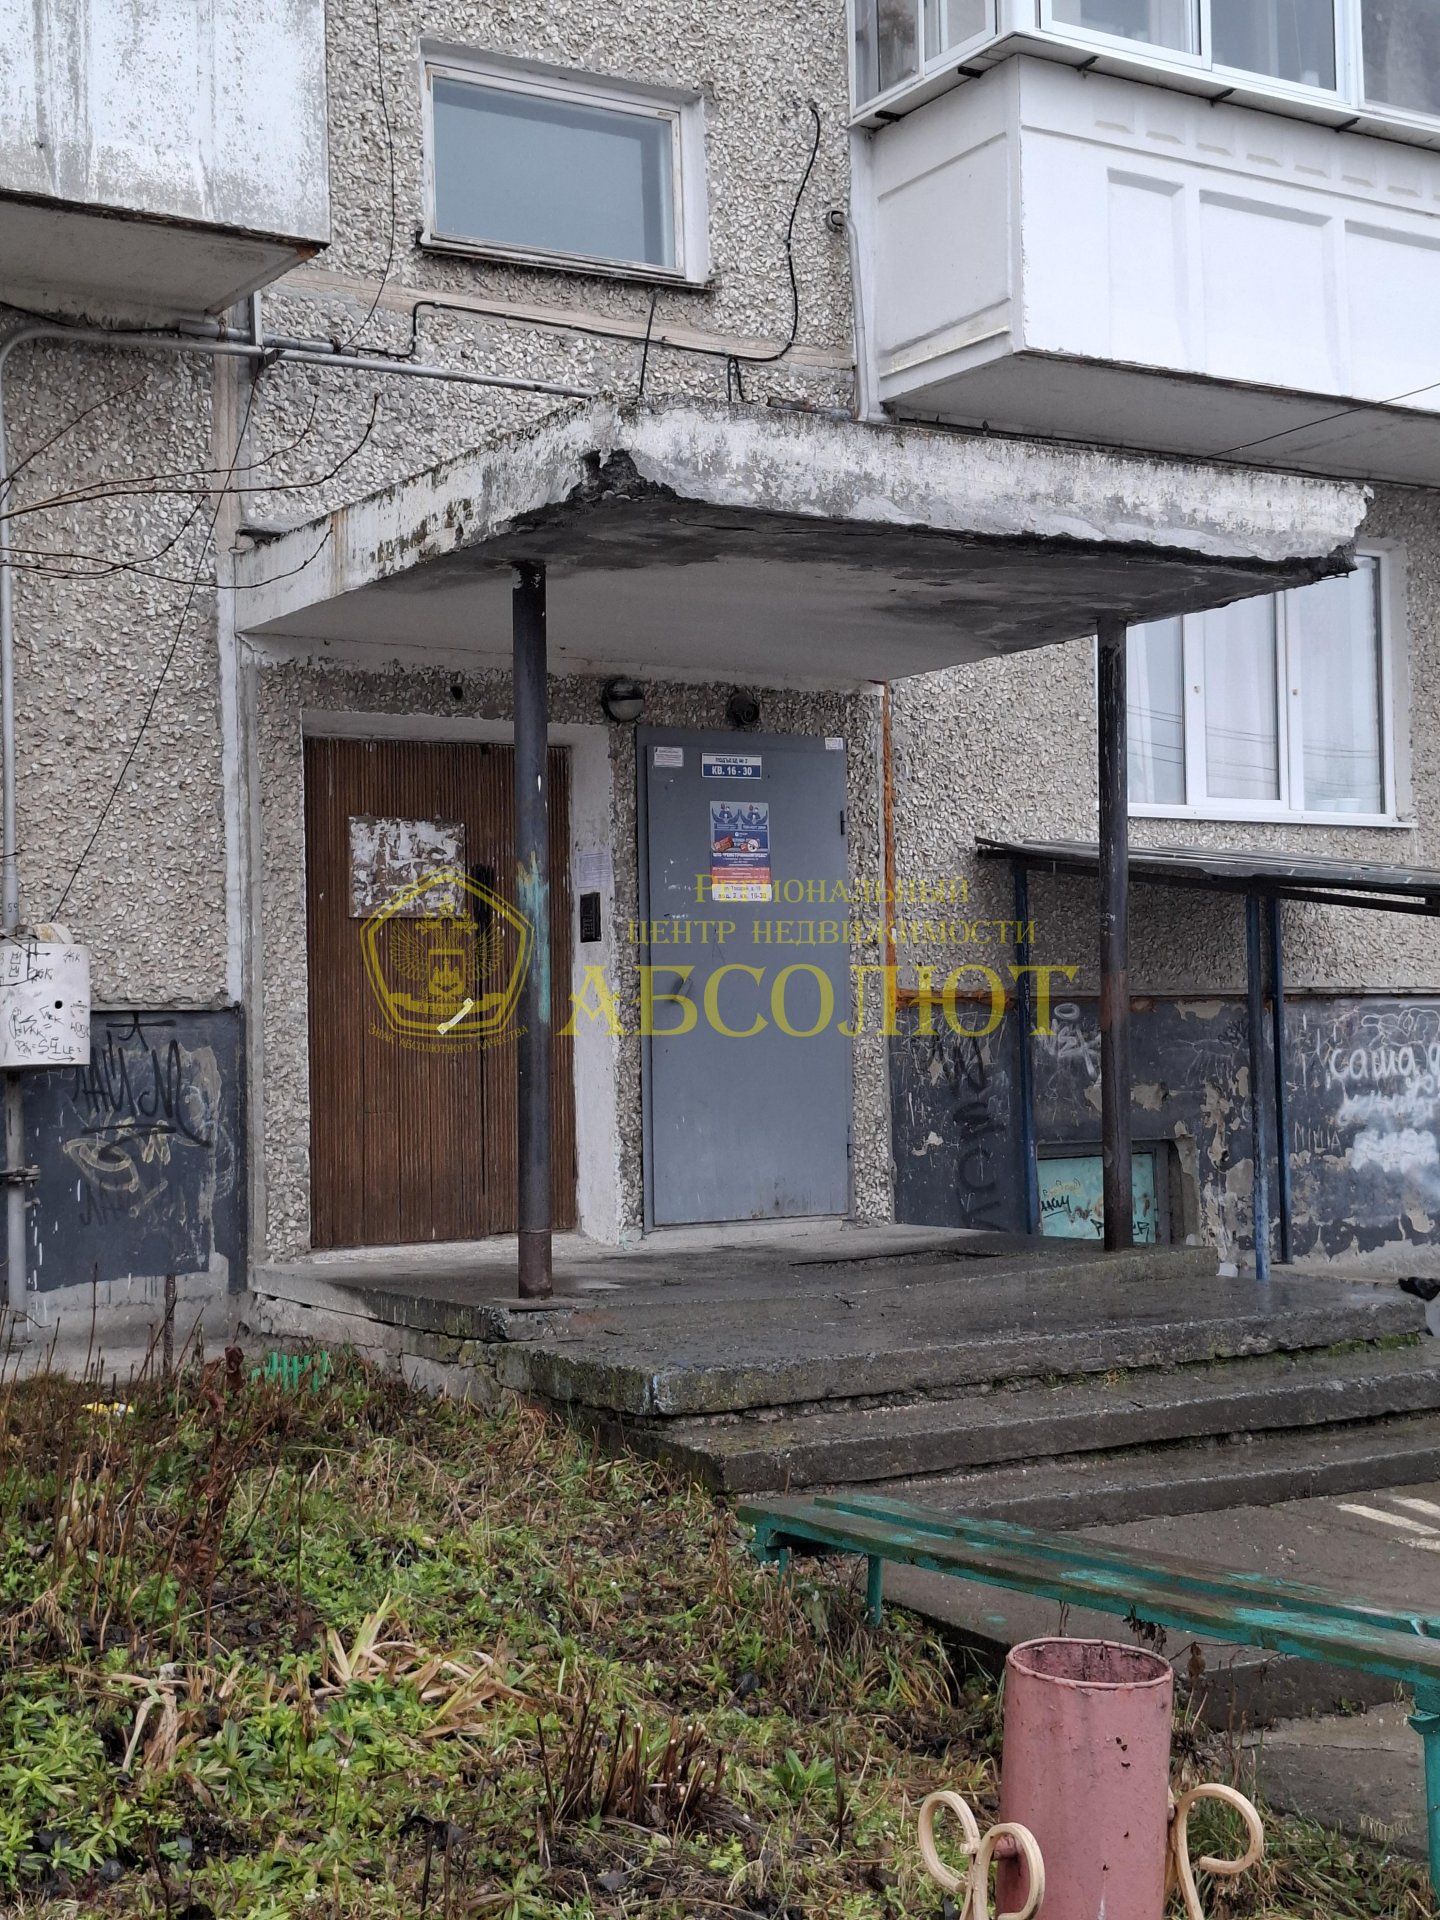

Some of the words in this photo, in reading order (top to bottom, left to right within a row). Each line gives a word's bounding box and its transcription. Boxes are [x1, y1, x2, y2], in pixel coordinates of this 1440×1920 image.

[711, 765, 725, 775] КВ.
[727, 766, 737, 775] 16
[742, 766, 753, 776] 30
